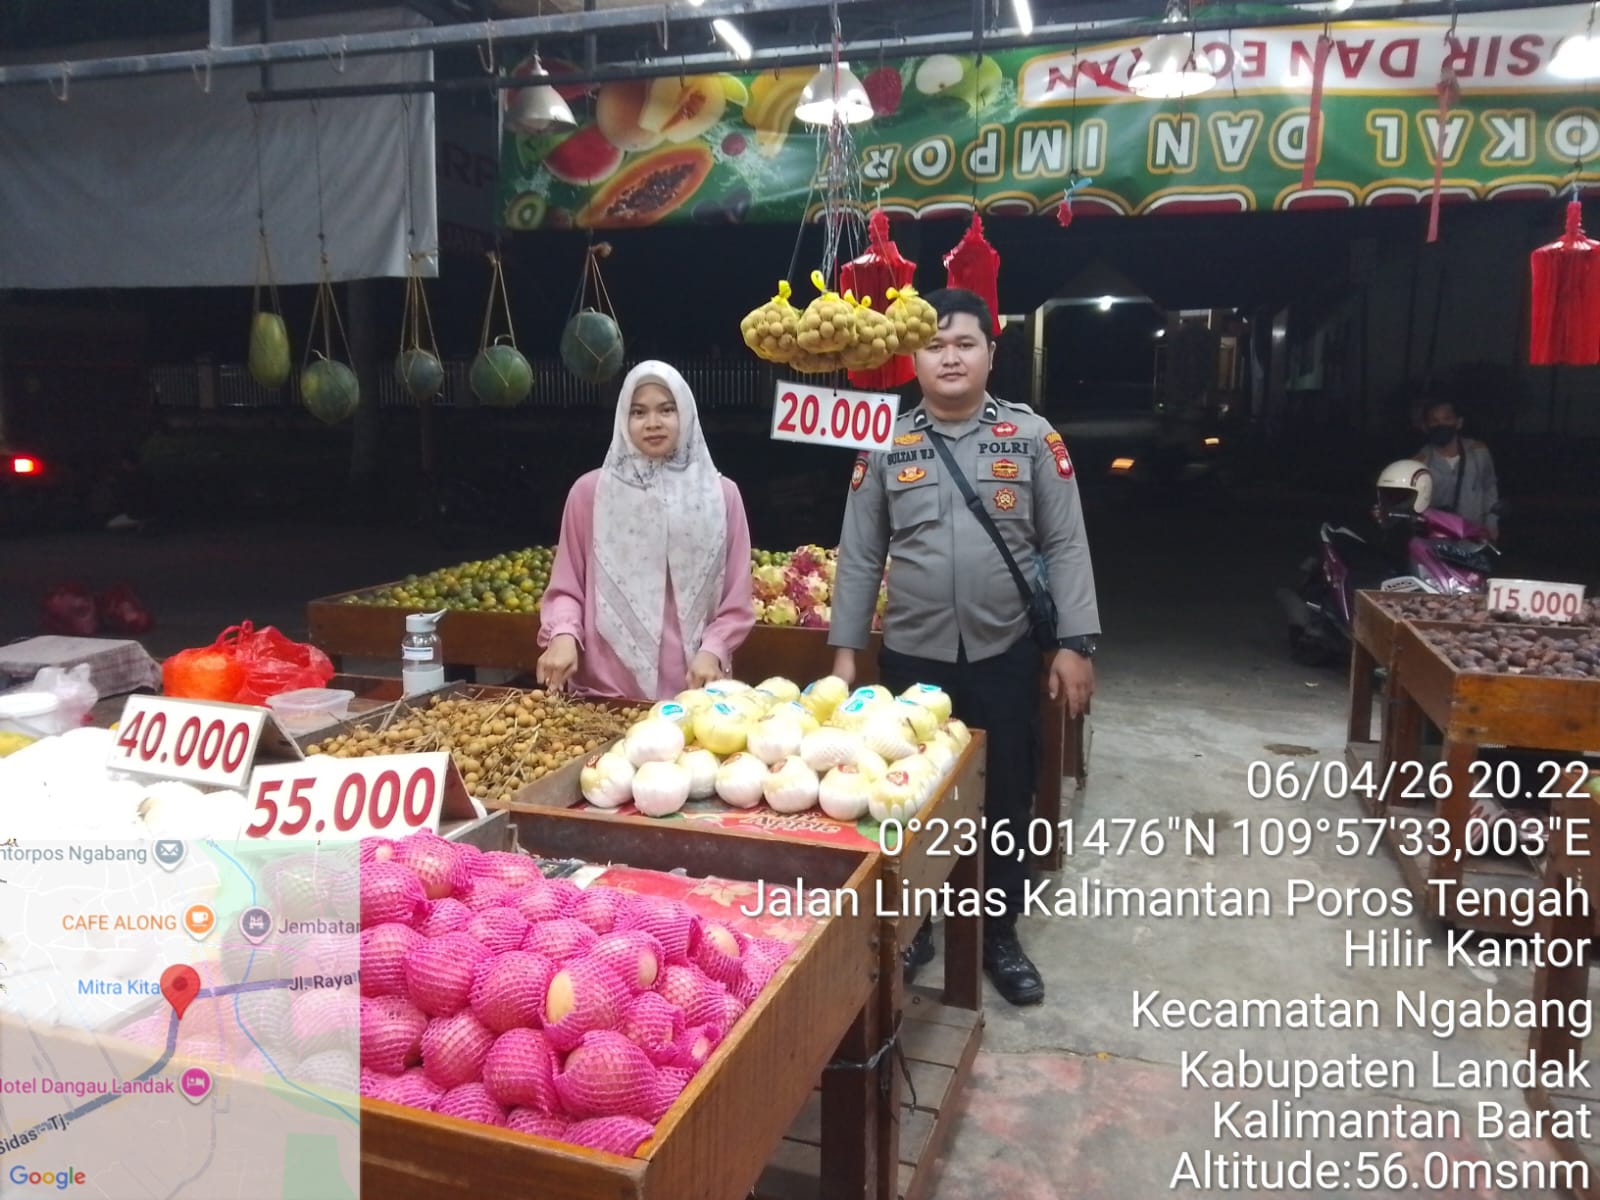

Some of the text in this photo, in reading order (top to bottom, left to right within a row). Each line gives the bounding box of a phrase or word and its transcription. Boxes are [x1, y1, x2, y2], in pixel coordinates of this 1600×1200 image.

[1289, 36, 1421, 79] DAN
[1441, 33, 1562, 78] SIR
[1152, 113, 1314, 167] DAN
[777, 391, 892, 444] 20.000
[978, 442, 1029, 454] POLRI
[1492, 586, 1578, 617] 15.000
[117, 710, 250, 774] 40.000
[246, 766, 436, 839] 55.000
